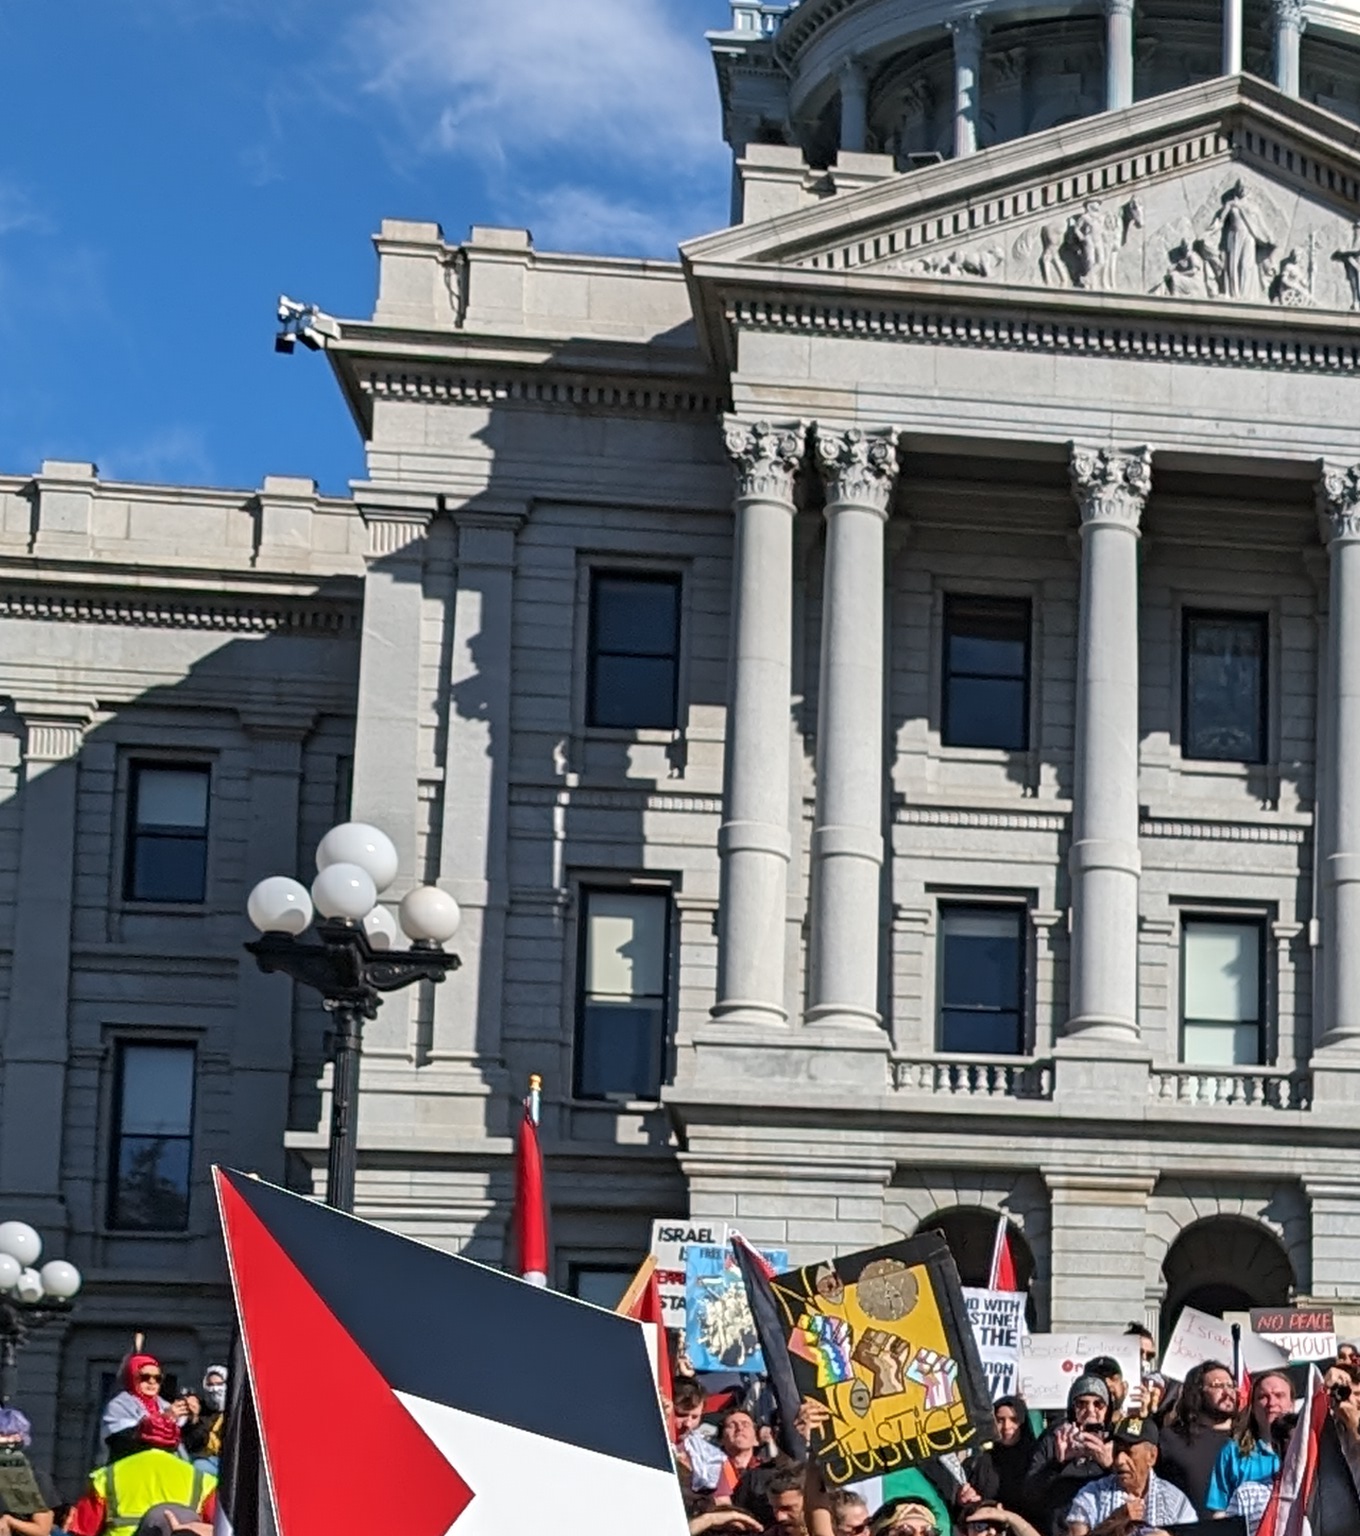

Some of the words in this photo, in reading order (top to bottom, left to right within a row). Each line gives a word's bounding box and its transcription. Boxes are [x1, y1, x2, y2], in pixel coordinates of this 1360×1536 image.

[658, 1228, 715, 1243] ISRAEL
[983, 1298, 1020, 1314] WITH
[972, 1312, 1018, 1329] STINE!
[1257, 1314, 1283, 1330] NO
[1289, 1313, 1331, 1329] PEACE
[980, 1328, 1017, 1347] THE
